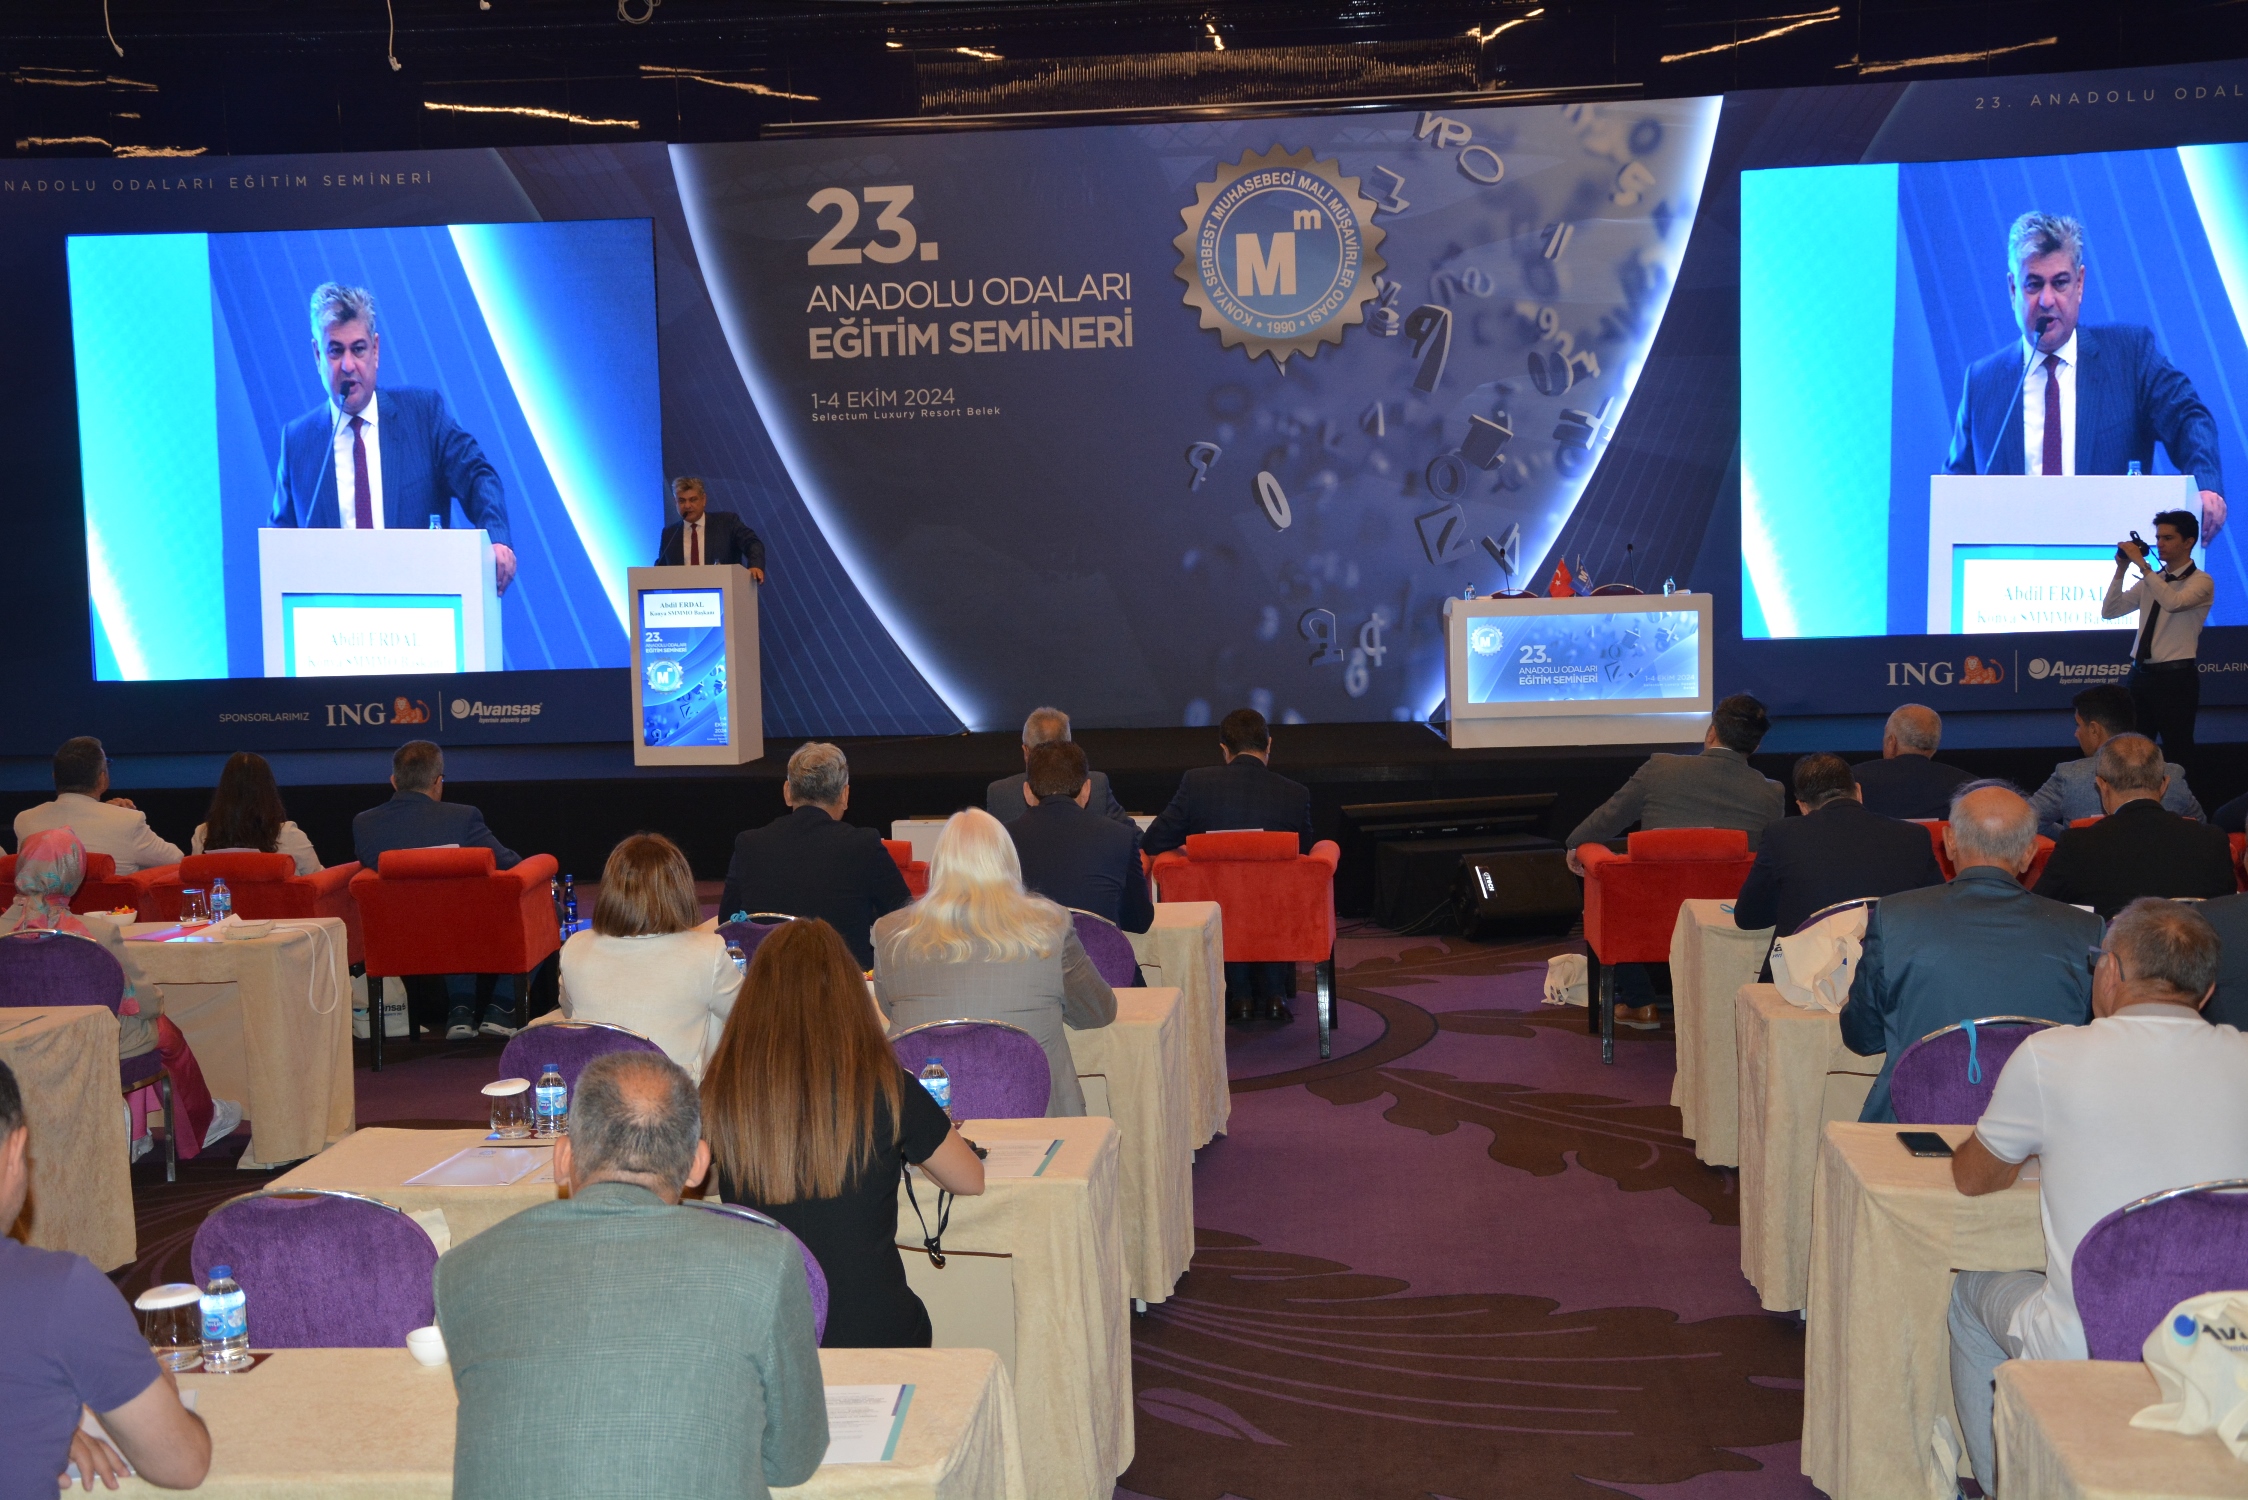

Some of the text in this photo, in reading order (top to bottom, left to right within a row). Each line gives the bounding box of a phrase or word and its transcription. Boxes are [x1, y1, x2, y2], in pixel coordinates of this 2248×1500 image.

[1975, 84, 2244, 109] 23. ANADOLU ODAL
[4, 170, 432, 192] NADOLU ODALARI EĞİTİM SEMİNERİ
[806, 185, 939, 266] 23.
[1200, 171, 1360, 327] KONYA SERBEST MUHASEBECİ MALİ MÜŞAVİRLER ODASI
[806, 272, 1131, 313] ANADOLU ODALARI
[809, 307, 1133, 360] EĞİTİM SEMİNERİ
[1266, 320, 1296, 334] 1990
[812, 387, 955, 409] 1-4 EKİM 2024
[812, 406, 1001, 422] Selectum Luxury Resort Belek
[645, 631, 663, 642] 23.
[1519, 644, 1552, 664] 23.
[1518, 665, 1598, 675] ANADOLU ODALARI
[1519, 672, 1598, 685] EĞİTİM SEMİNERİ
[1886, 661, 1955, 687] ING
[2050, 661, 2131, 677] Avansas
[219, 711, 310, 723] SPONSORLARIMIZ
[325, 702, 387, 727] ING
[470, 701, 542, 716] Avansas
